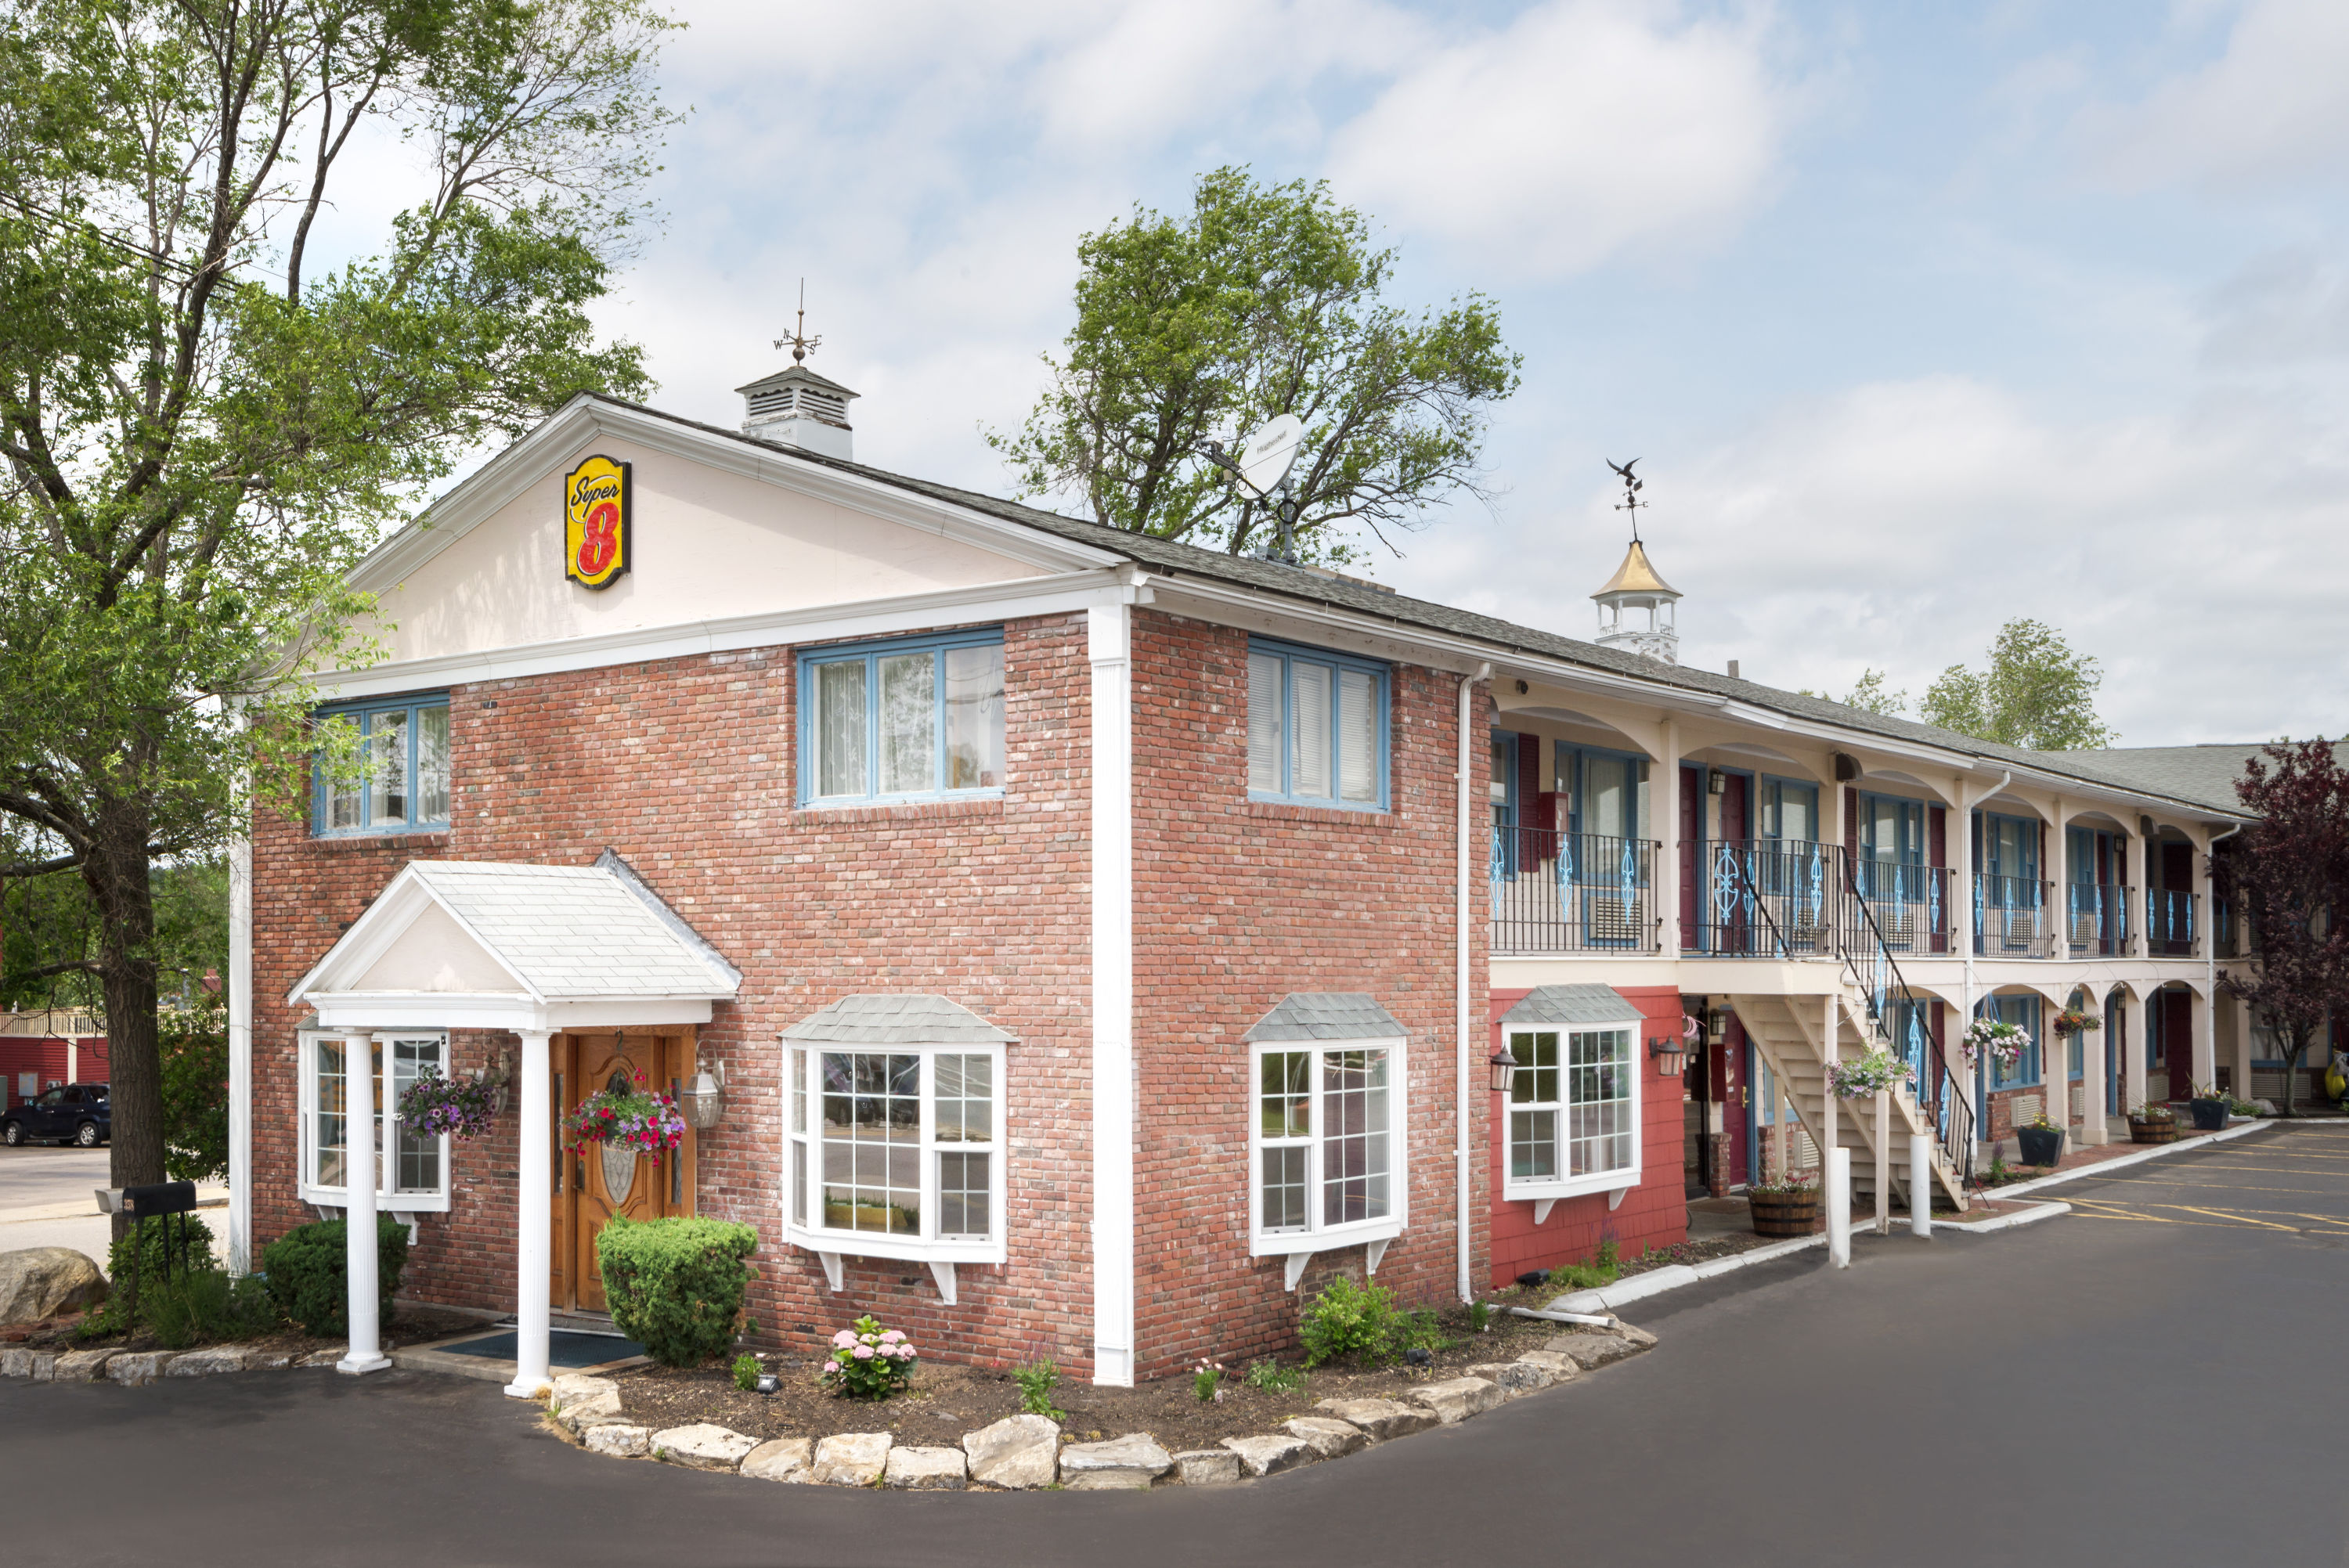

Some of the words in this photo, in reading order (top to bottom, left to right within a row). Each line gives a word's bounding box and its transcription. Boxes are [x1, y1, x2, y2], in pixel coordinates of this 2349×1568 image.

[1257, 429, 1287, 454] HughesNet
[571, 475, 620, 519] Super
[577, 502, 620, 575] 8
